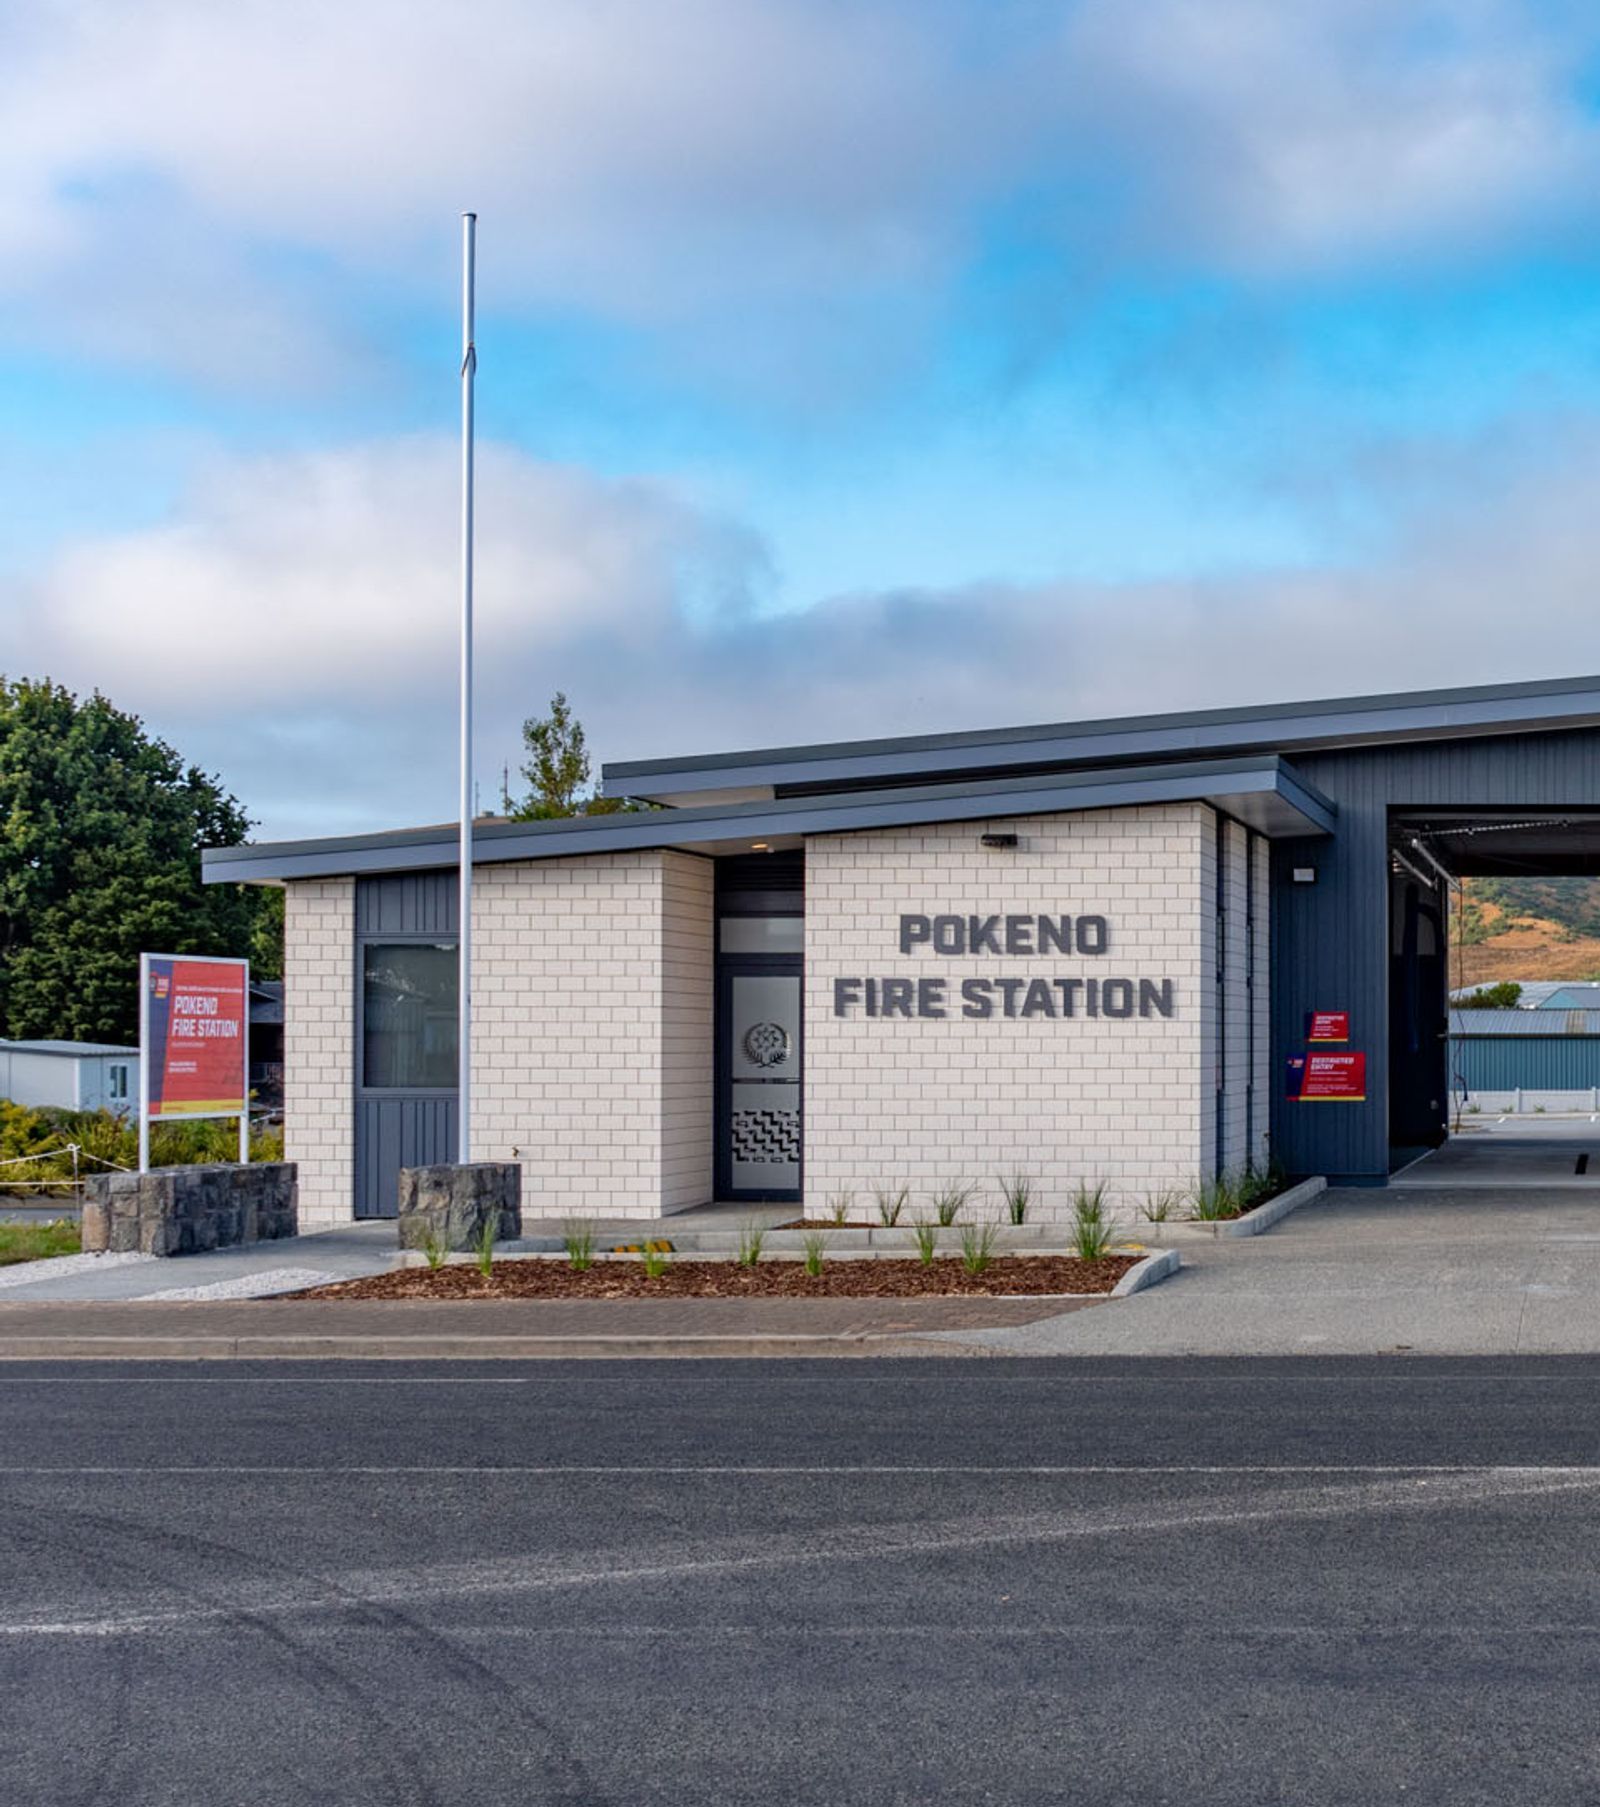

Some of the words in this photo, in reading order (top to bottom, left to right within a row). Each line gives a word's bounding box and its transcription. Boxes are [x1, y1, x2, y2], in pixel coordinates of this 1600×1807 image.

[899, 914, 1108, 955] POKENO
[174, 995, 218, 1015] POKENO
[834, 978, 947, 1018] FIRE
[961, 978, 1173, 1018] STATION
[172, 1018, 197, 1037] FIRE
[198, 1018, 239, 1037] STATION
